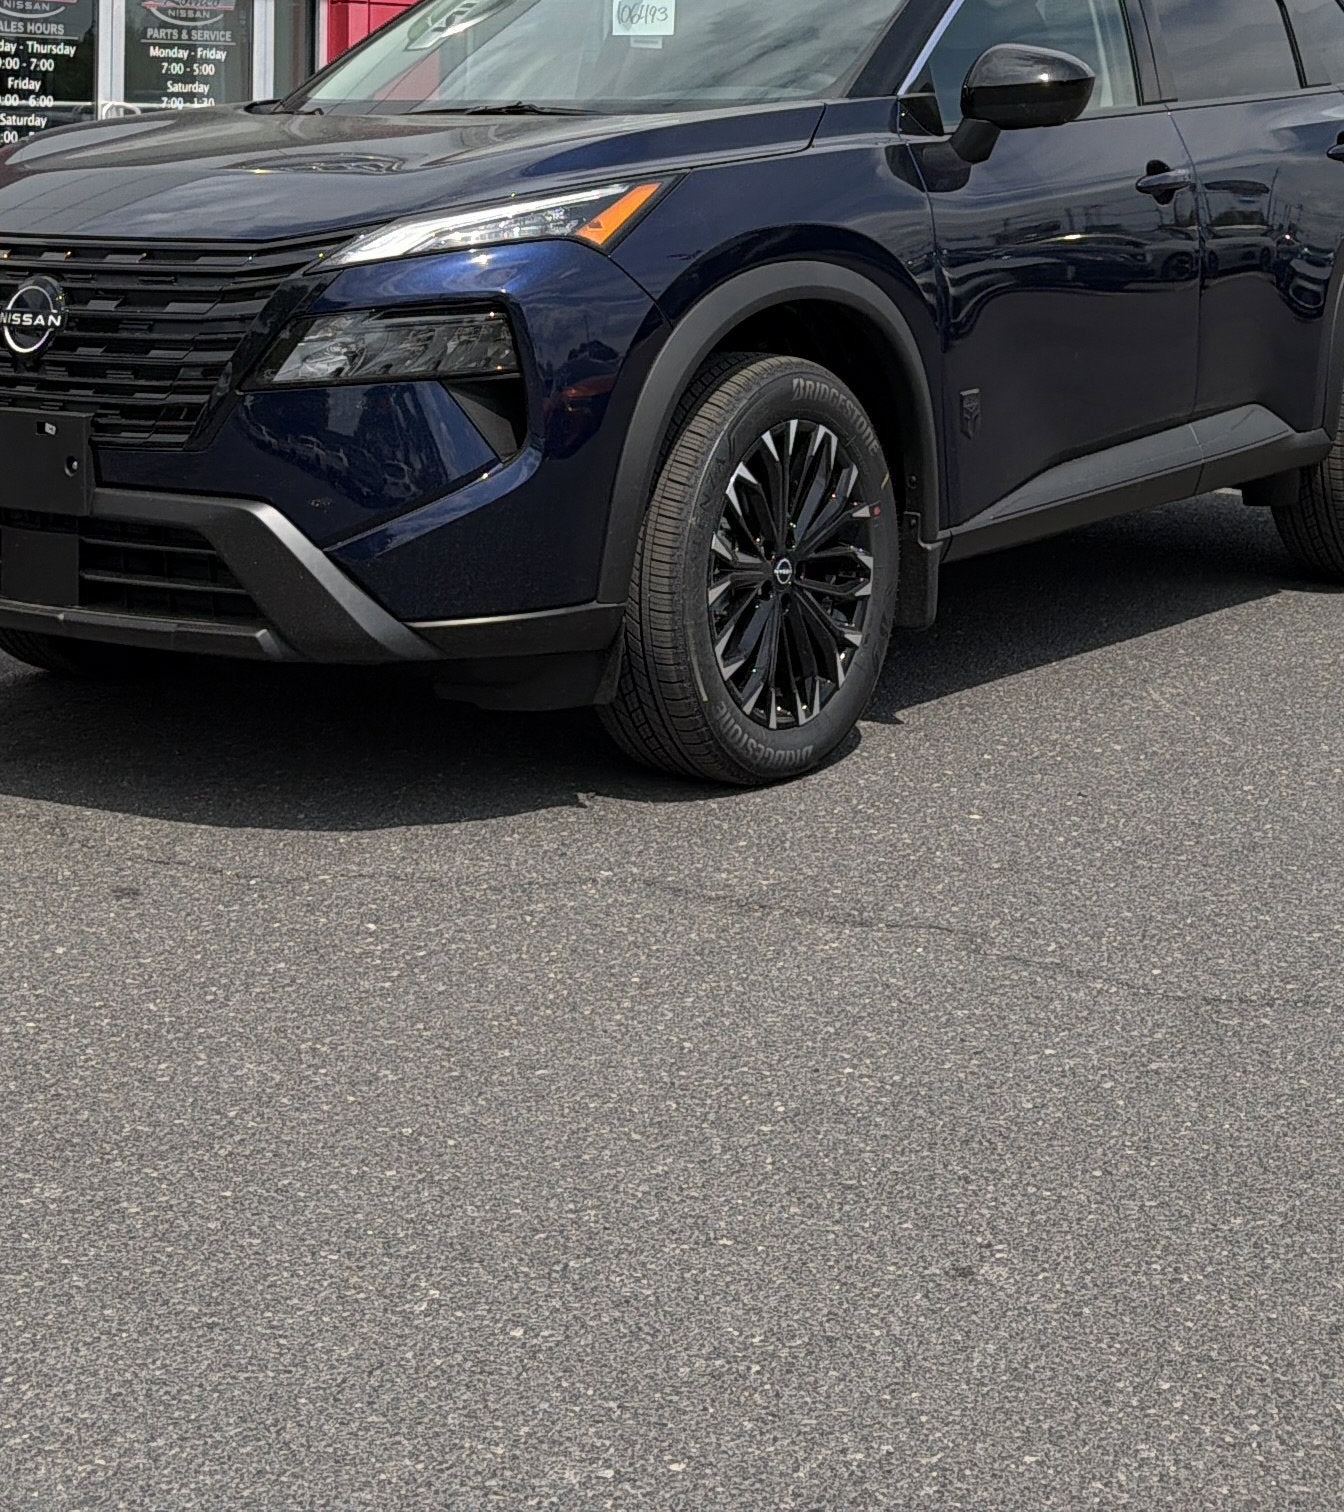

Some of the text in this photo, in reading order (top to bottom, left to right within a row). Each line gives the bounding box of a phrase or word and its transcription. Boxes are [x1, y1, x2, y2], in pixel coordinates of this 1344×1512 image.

[2, 0, 51, 11] NISSAN
[167, 8, 211, 19] NISSAN
[27, 22, 65, 36] HOURS
[146, 28, 232, 42] PARTS & SERVICE
[26, 40, 77, 58] Thursday
[149, 46, 189, 61] Monday
[197, 47, 227, 62] Friday
[29, 58, 55, 72] 7:00
[161, 62, 184, 75] 7:00
[193, 63, 216, 76] 5:00
[7, 76, 42, 92] Friday
[166, 80, 210, 95] Saturday
[28, 95, 54, 108] 6:00
[161, 96, 184, 110] 7:00
[0, 113, 48, 128] Saturday
[0, 311, 62, 327] NISSAN
[792, 377, 882, 456] BRIDGESTONE
